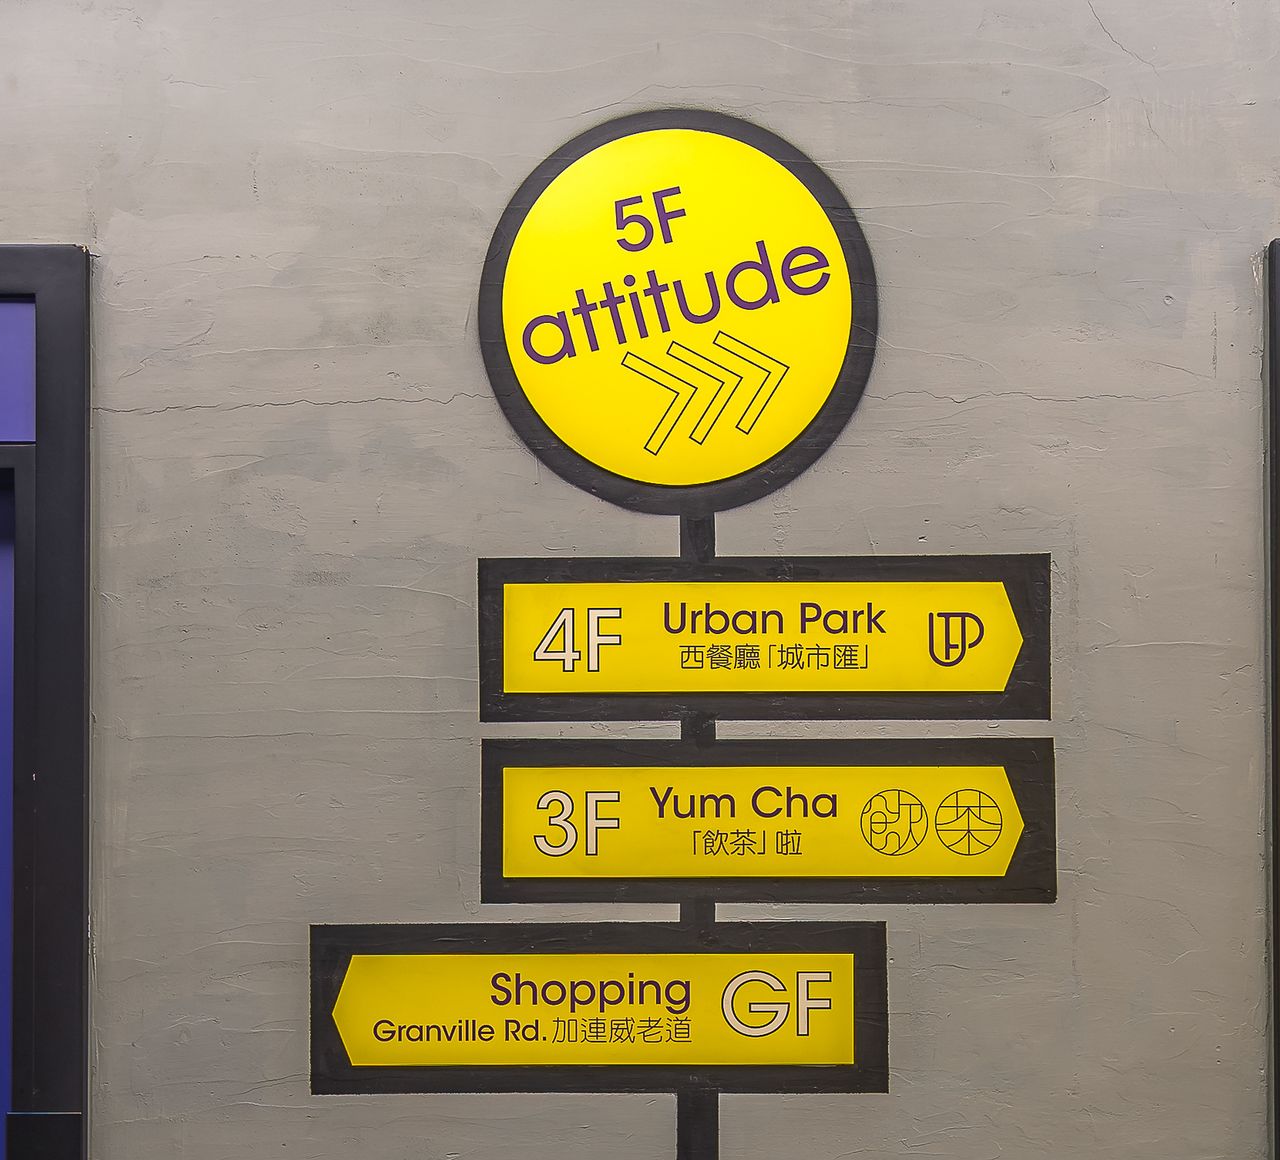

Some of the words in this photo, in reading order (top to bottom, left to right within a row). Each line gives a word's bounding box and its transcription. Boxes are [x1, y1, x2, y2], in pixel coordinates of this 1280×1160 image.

[614, 186, 687, 253] 5F
[522, 240, 831, 365] attitude
[533, 607, 622, 673] 4F
[663, 602, 783, 634] Urban
[800, 602, 887, 634] Park
[533, 790, 620, 857] 3F
[649, 787, 736, 819] Yum
[751, 787, 838, 819] Cha
[490, 972, 691, 1014] Shopping
[721, 970, 832, 1038] GF
[372, 1019, 495, 1043] Granville
[504, 1019, 548, 1042] Rd.
[551, 1016, 693, 1044] 加連威老道
